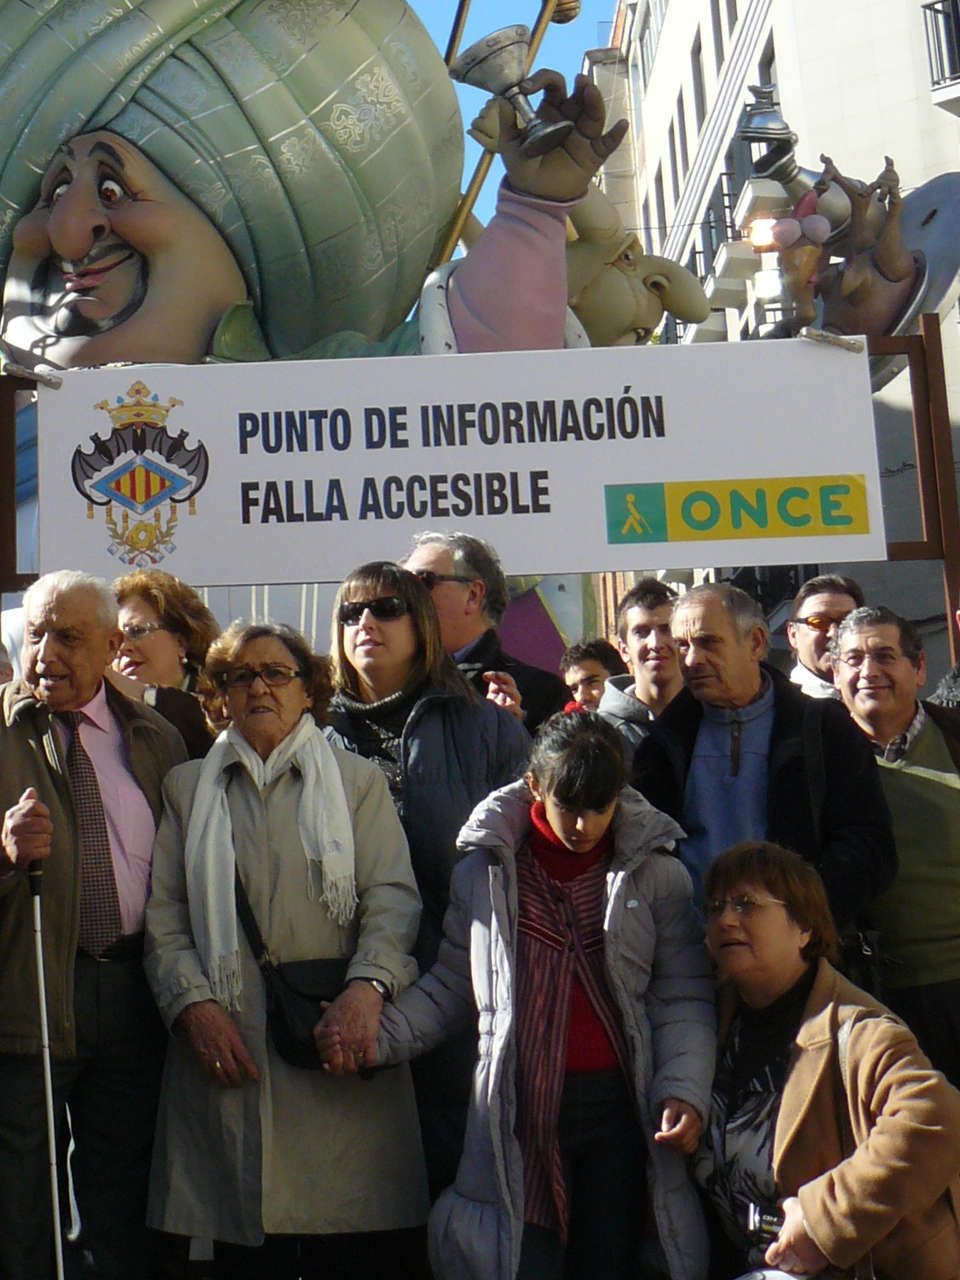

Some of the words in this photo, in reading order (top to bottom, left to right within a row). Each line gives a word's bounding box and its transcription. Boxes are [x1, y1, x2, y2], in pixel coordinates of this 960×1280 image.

[238, 407, 352, 455] PUNTO
[363, 405, 410, 450] DE
[420, 385, 666, 448] INFORMACIÓN
[240, 478, 349, 525] FALLA
[358, 470, 551, 521] ACCESIBLE
[680, 484, 854, 532] ONCE
